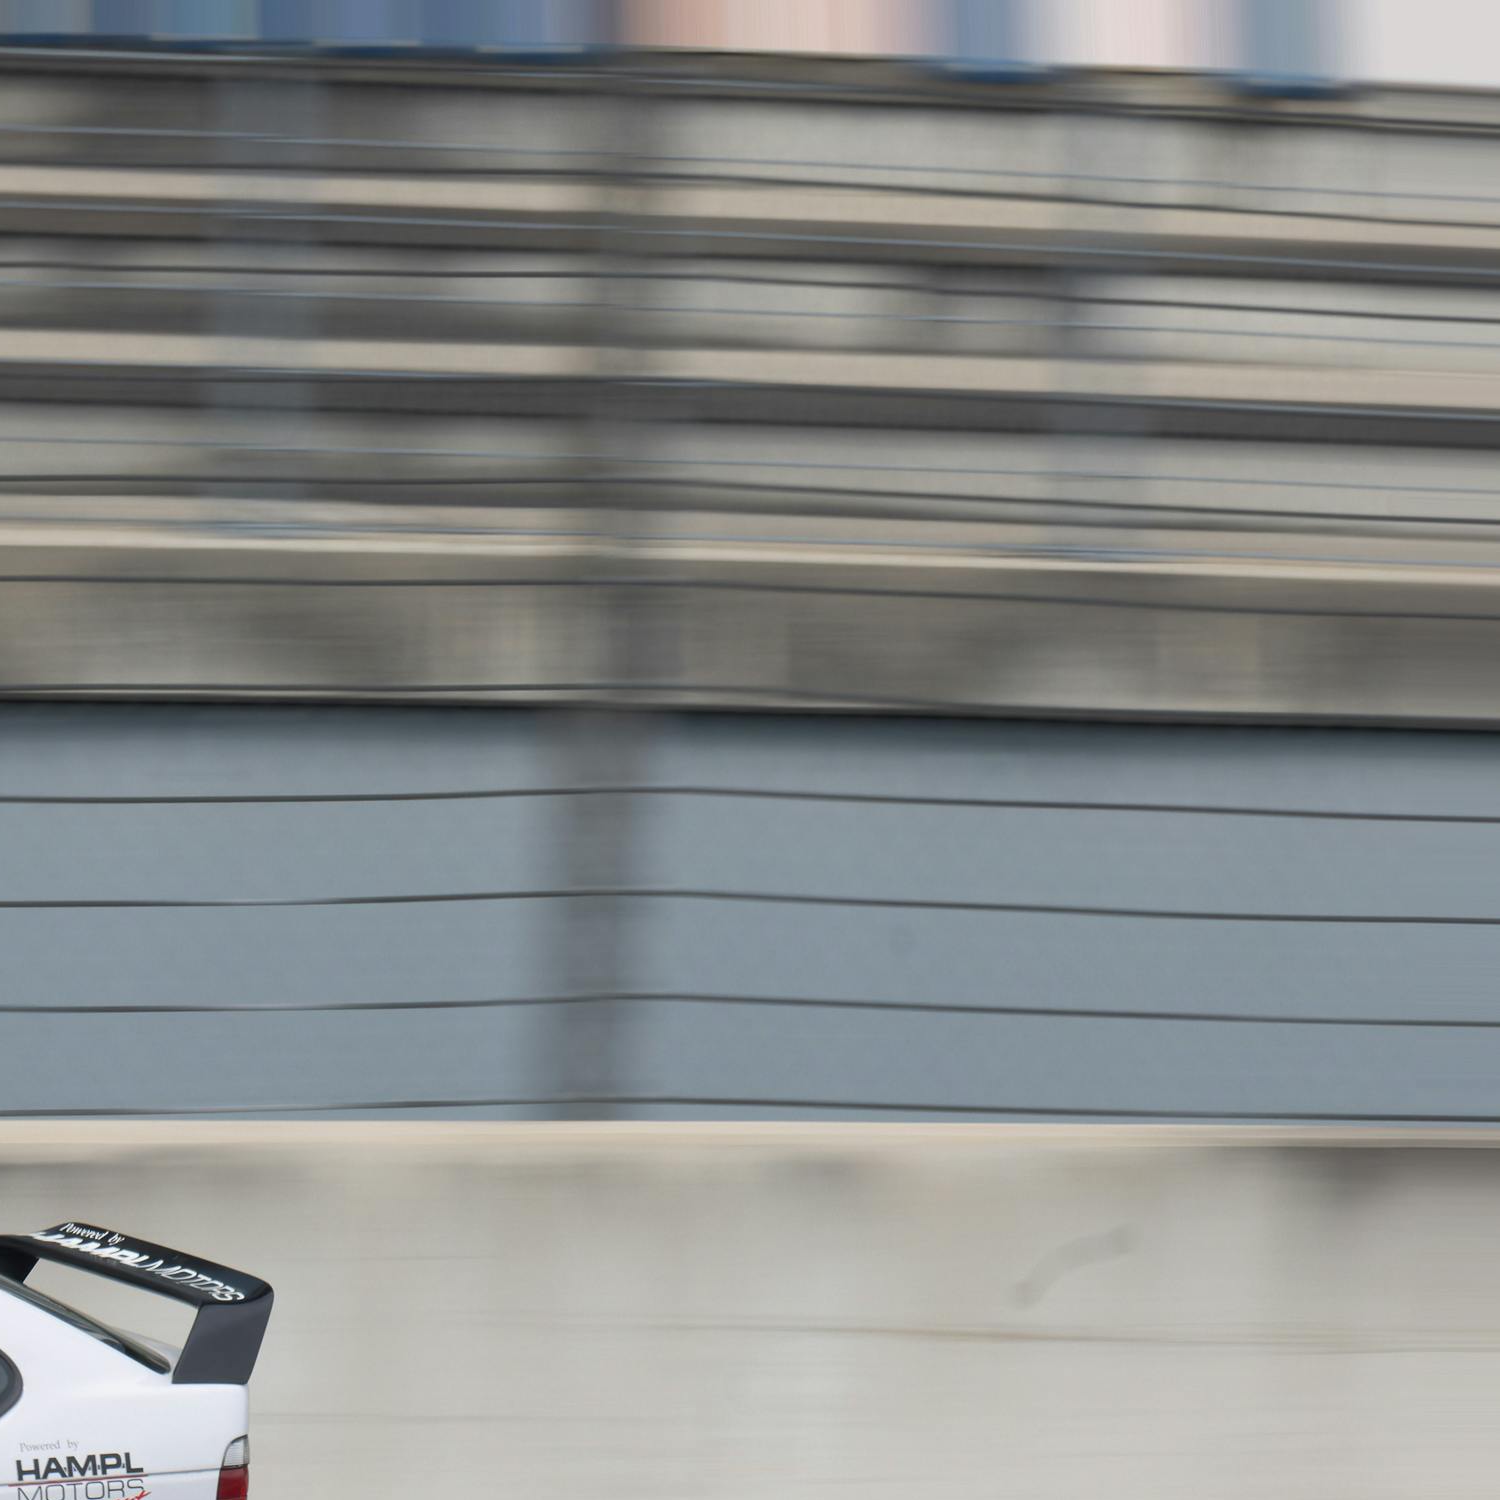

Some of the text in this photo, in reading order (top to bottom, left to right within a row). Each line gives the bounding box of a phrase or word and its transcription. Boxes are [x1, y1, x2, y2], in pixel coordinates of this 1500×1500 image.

[19, 1439, 80, 1453] Powered by
[16, 1452, 144, 1481] HAMPL
